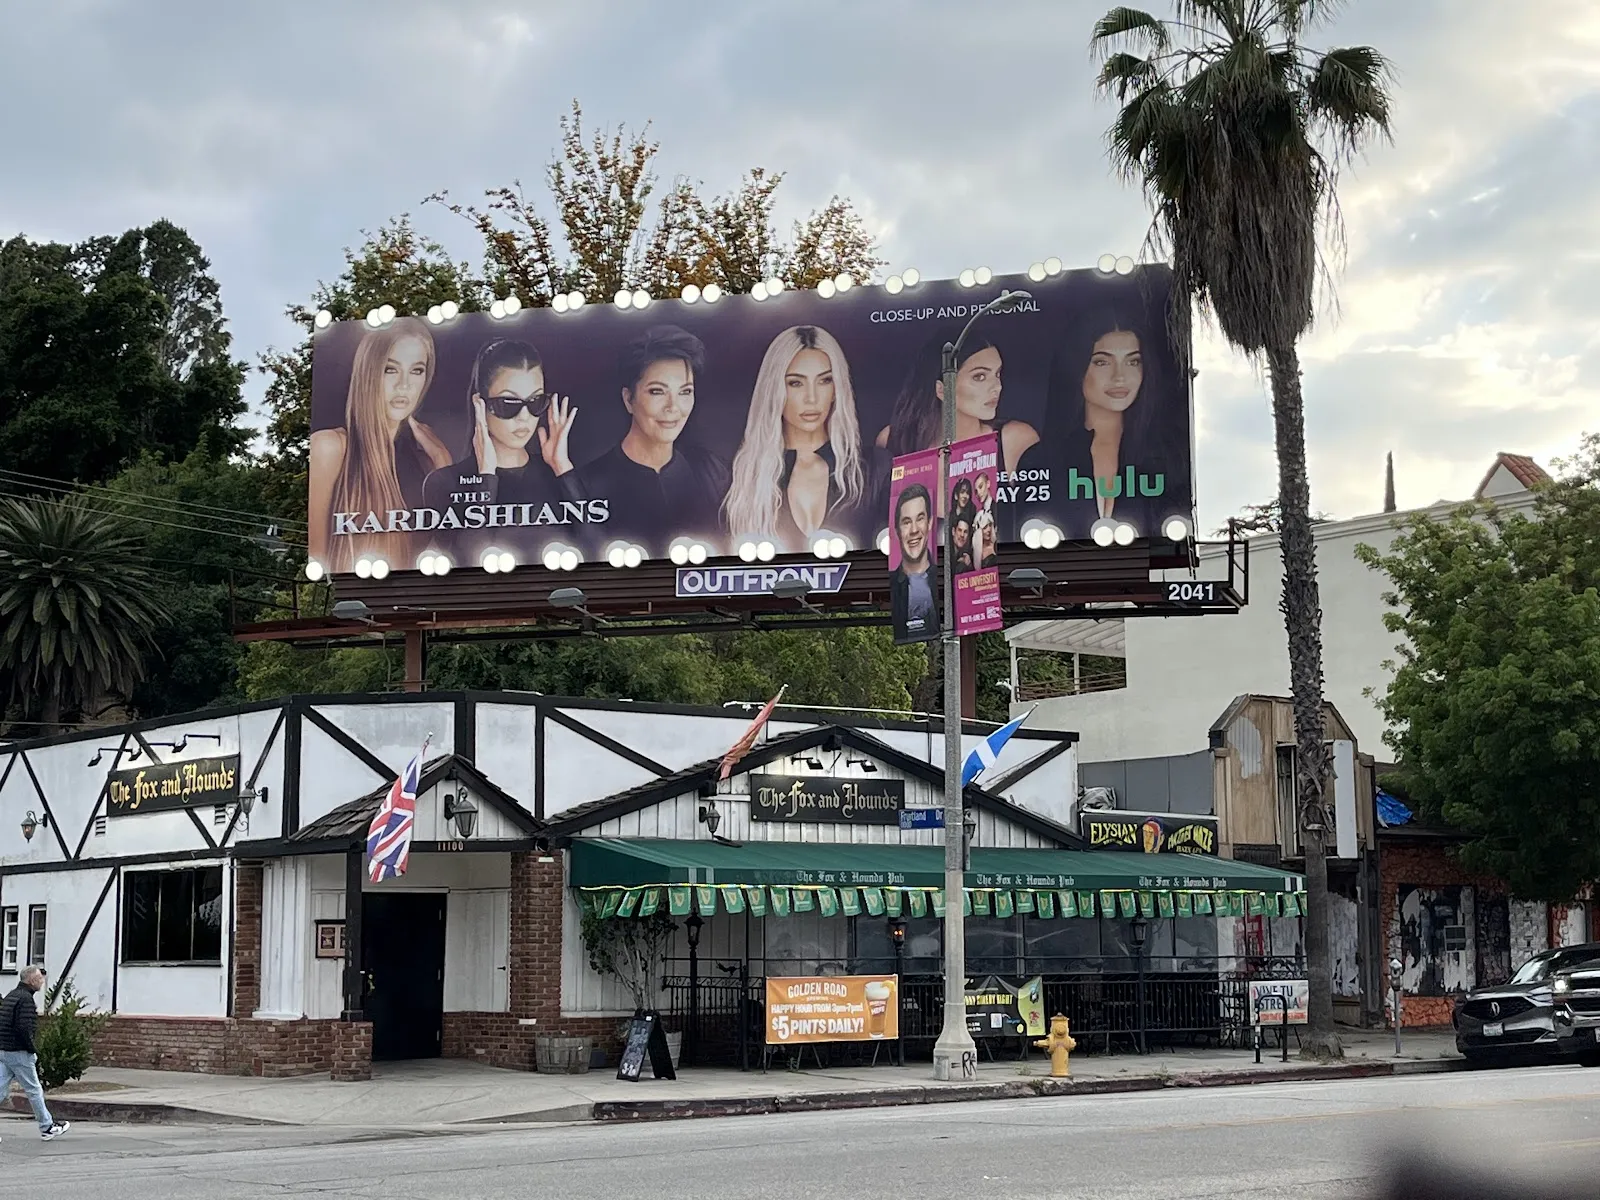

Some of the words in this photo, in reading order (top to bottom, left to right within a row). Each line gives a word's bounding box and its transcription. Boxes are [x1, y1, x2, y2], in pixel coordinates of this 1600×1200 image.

[870, 307, 934, 323] CLOSE-UP
[937, 305, 968, 319] AND
[459, 474, 483, 486] hulu
[1068, 465, 1165, 500] hulu
[450, 490, 491, 505] THE
[996, 486, 1020, 503] AY
[1025, 485, 1051, 502] 25
[333, 499, 610, 535] KARDASHIANS
[1168, 583, 1213, 601] 2041
[109, 780, 131, 809] The
[130, 770, 158, 809] Fox
[160, 768, 181, 797] and
[181, 760, 235, 804] Hounds
[757, 786, 786, 814] The
[785, 780, 816, 818] Fox
[818, 789, 840, 809] and
[841, 783, 898, 819] Hounds
[935, 809, 943, 821] Dr
[1090, 822, 1138, 845] ELYSIAN
[796, 870, 813, 883] The
[818, 870, 835, 883] Fox
[840, 871, 847, 883] &
[851, 871, 884, 883] Hounds
[888, 872, 905, 885] Pub
[976, 874, 992, 887] The
[995, 873, 1011, 885] Fox
[1015, 874, 1022, 885] &
[1026, 874, 1056, 886] Hounds
[1059, 874, 1075, 888] Pub
[1138, 876, 1153, 888] The
[1155, 876, 1170, 887] Fox
[1173, 877, 1180, 887] &
[1183, 876, 1210, 888] Hounds
[1212, 877, 1227, 888] Pub
[787, 982, 822, 999] GOLDEN
[823, 982, 847, 997] ROAD
[1280, 985, 1293, 997] TU
[770, 1003, 795, 1014] HAPPY
[795, 1003, 813, 1013] HOUR
[813, 1003, 832, 1013] FROM
[772, 1015, 790, 1040] $5
[790, 1018, 827, 1035] PINTS
[828, 1017, 864, 1033] DAILY!
